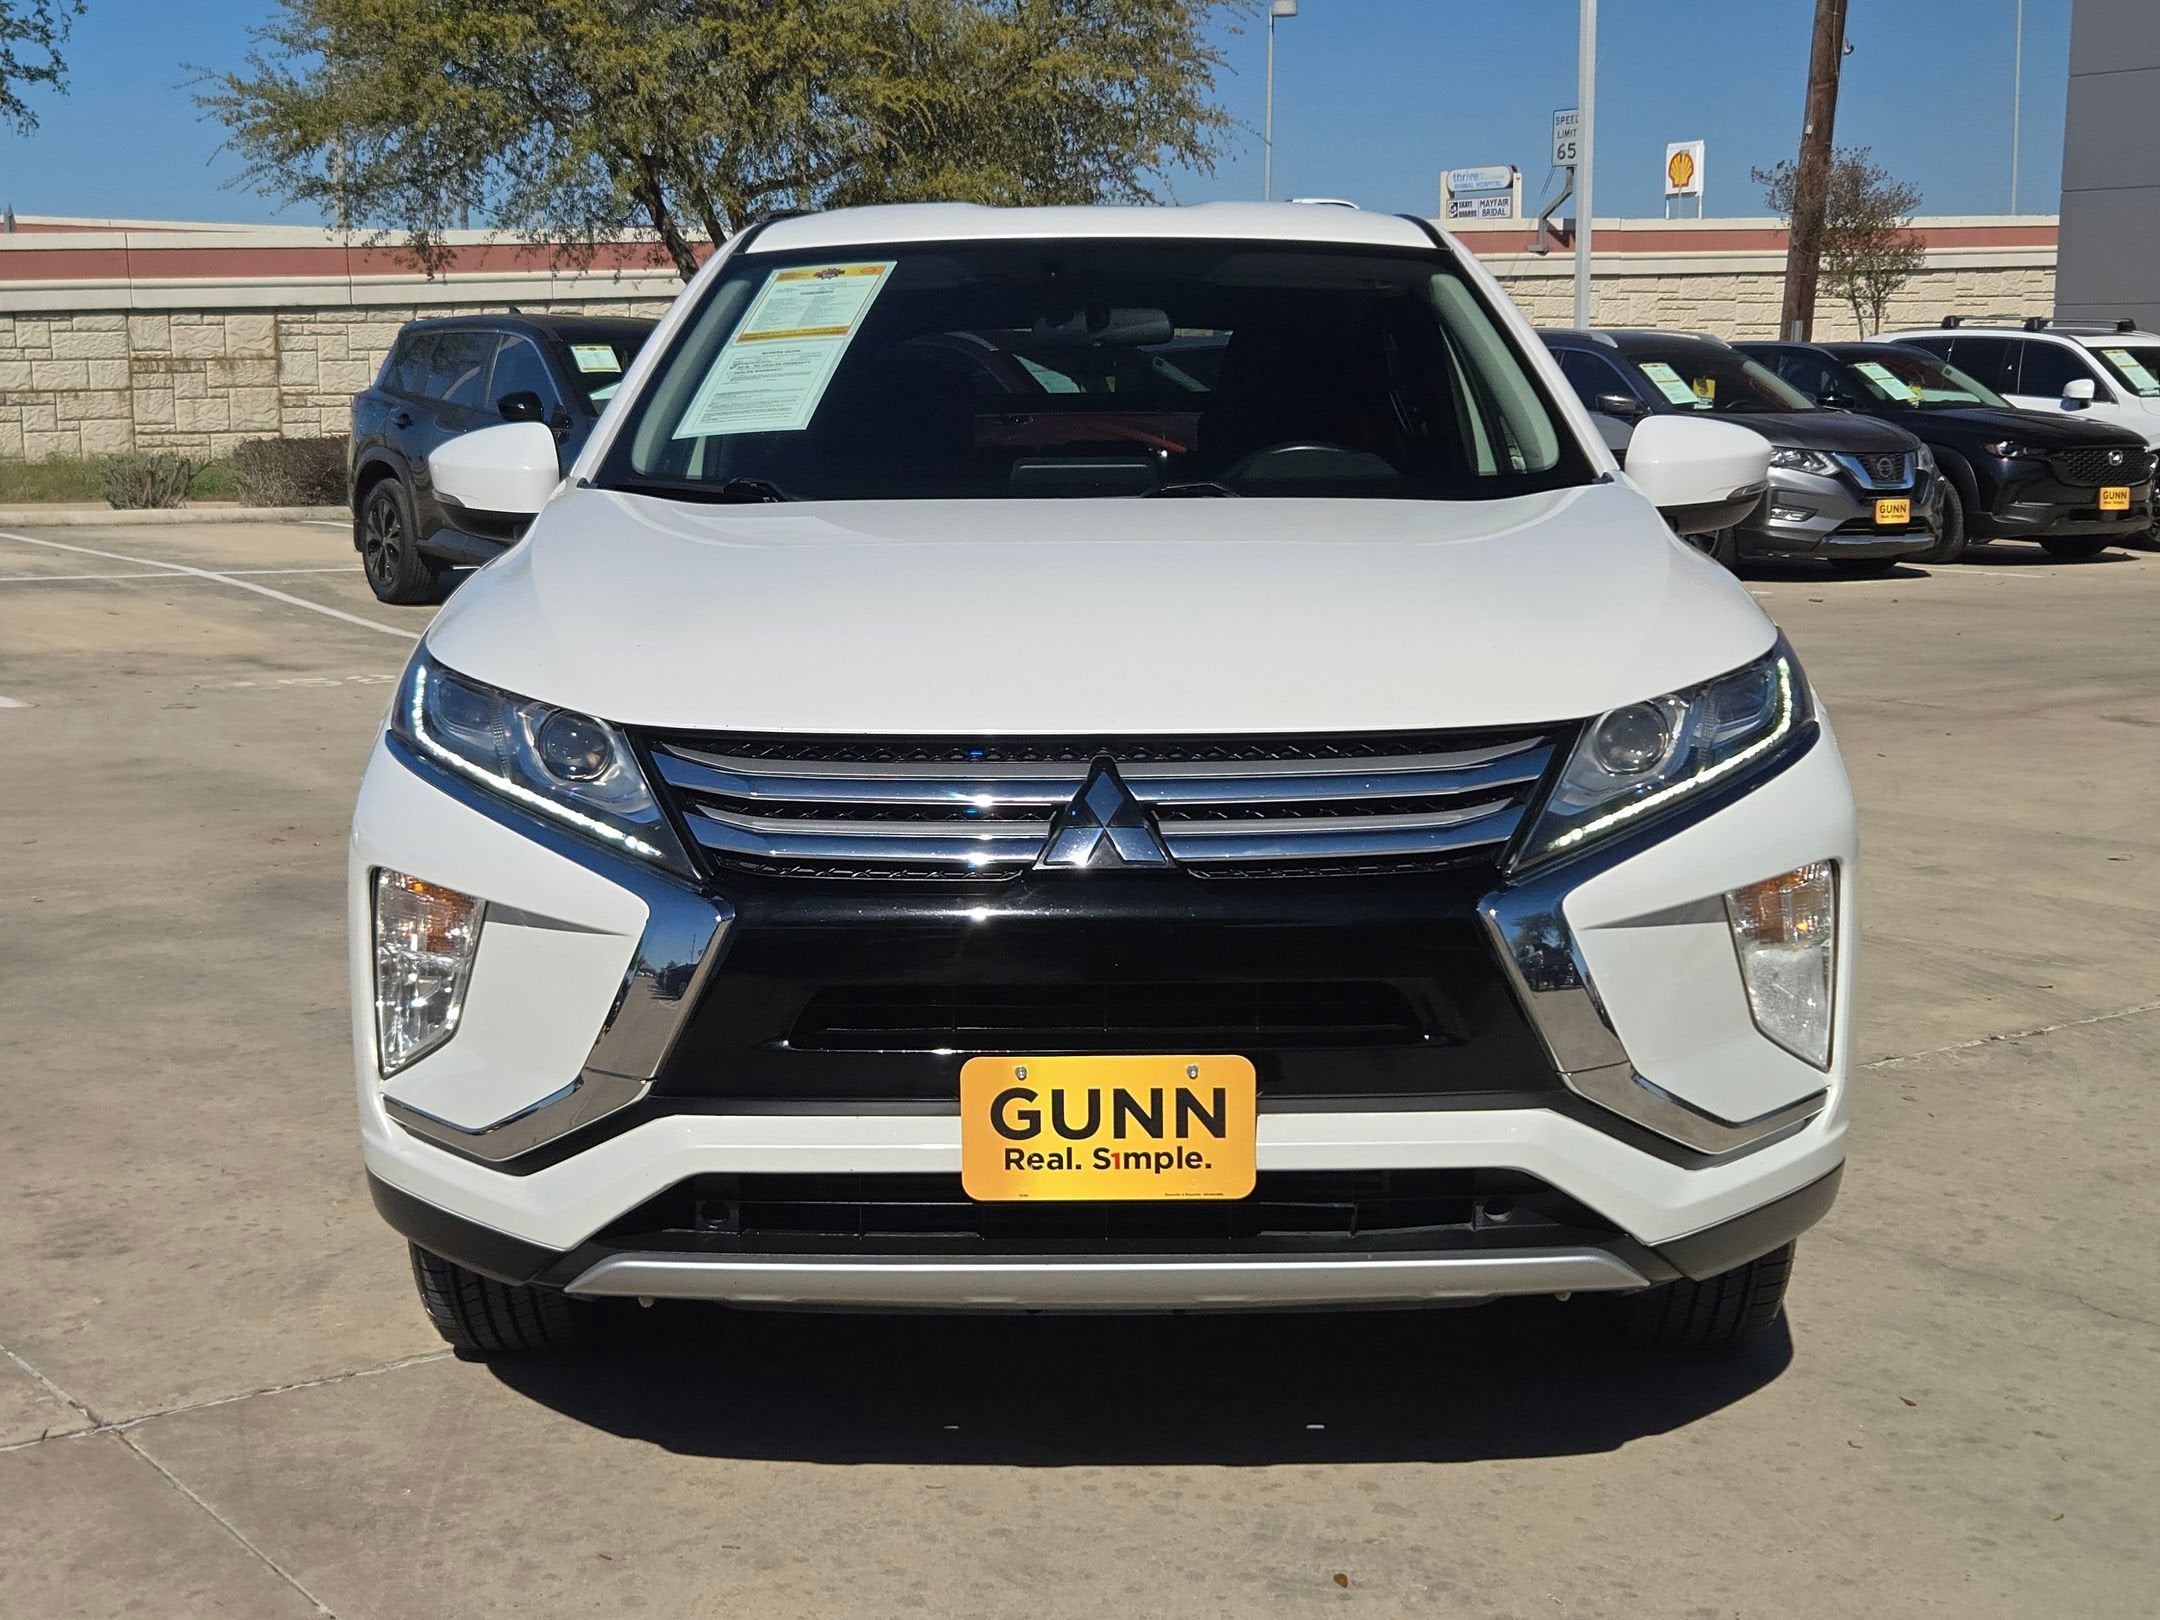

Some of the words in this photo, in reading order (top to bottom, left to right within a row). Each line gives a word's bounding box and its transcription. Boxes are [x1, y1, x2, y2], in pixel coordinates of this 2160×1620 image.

[1557, 128, 1577, 139] LIMIT
[1557, 142, 1577, 160] 65
[1453, 171, 1479, 182] thrive
[1479, 198, 1509, 208] MAYFAIR
[1481, 207, 1507, 217] BRIDAL
[2103, 490, 2127, 500] GUNN
[1879, 503, 1907, 514] GUNN
[990, 1087, 1226, 1140] GUNN
[1004, 1147, 1082, 1171] Real.
